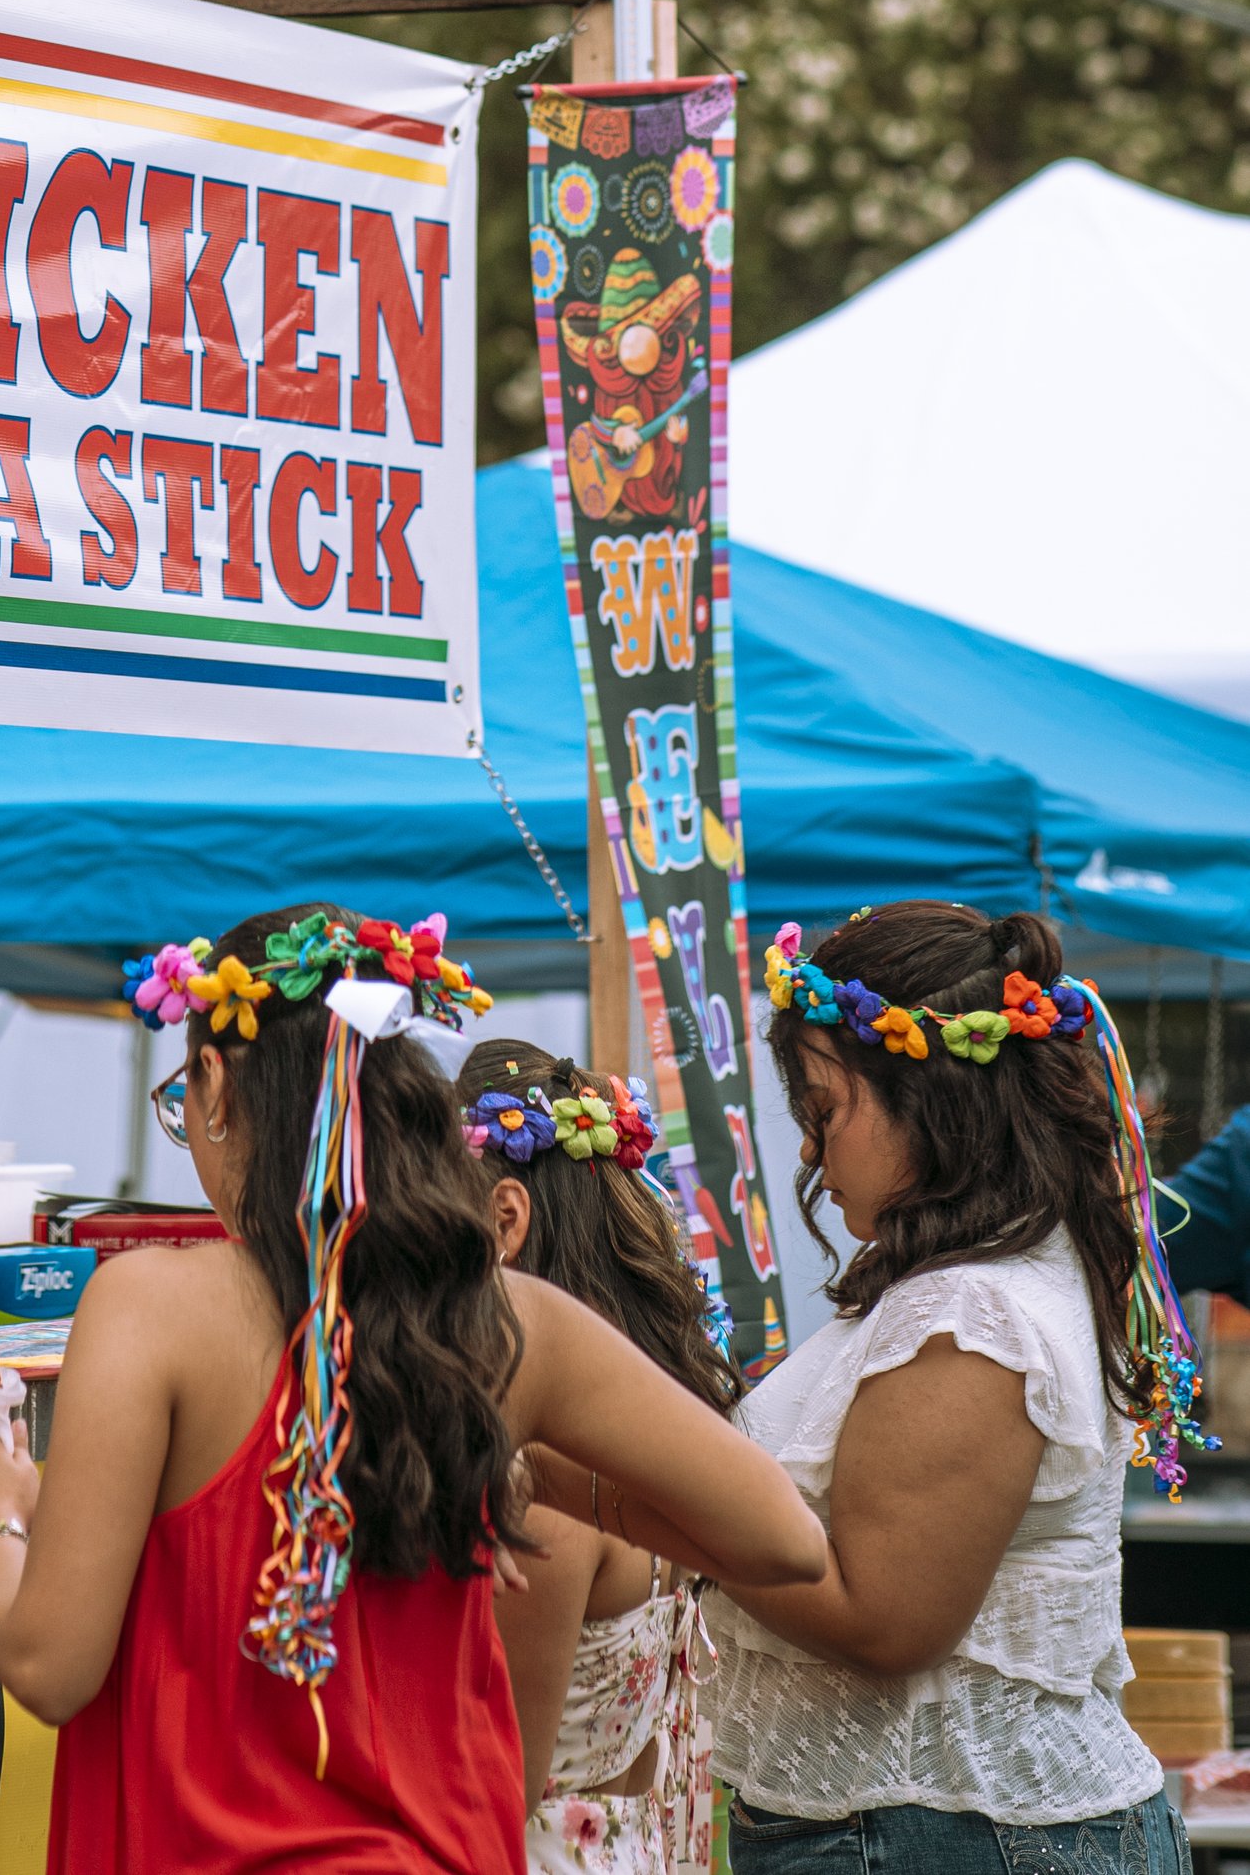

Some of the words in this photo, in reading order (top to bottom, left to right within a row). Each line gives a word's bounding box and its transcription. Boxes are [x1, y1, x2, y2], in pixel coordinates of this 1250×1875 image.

[76, 425, 424, 618] STICK
[79, 1237, 123, 1249] WHITE
[21, 1263, 74, 1299] Ziploc
